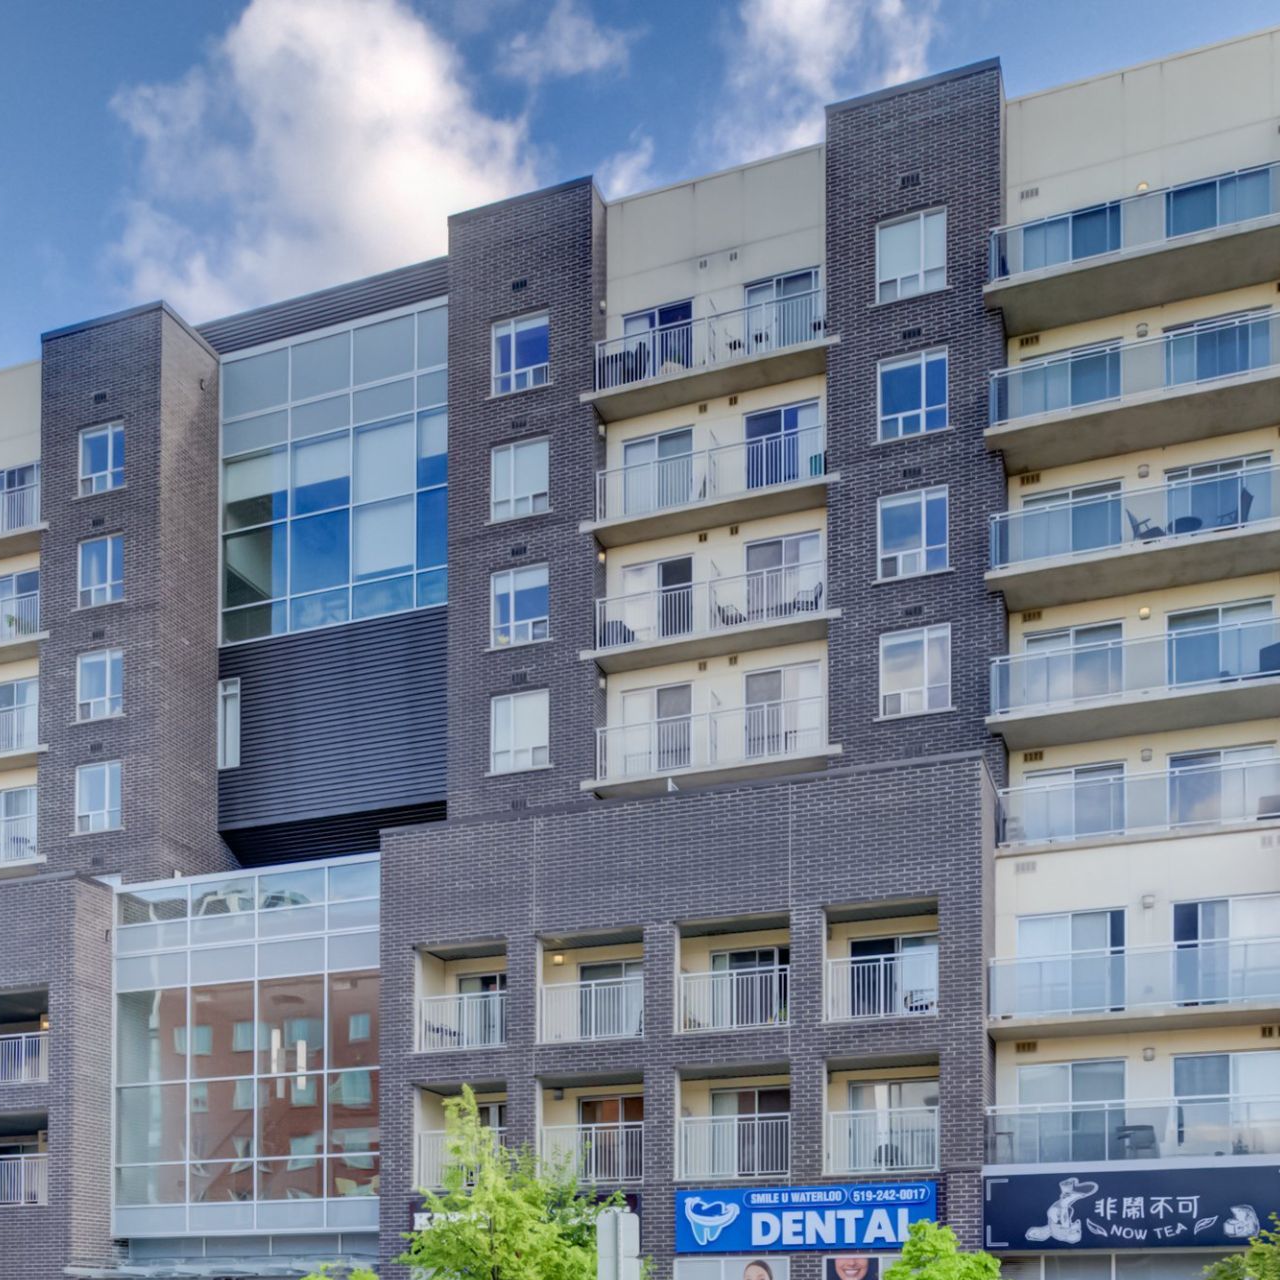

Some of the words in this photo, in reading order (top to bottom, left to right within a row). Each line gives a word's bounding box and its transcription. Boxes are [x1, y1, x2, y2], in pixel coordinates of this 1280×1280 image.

[751, 1192, 779, 1204] SMILE
[781, 1192, 789, 1203] U
[791, 1190, 842, 1203] WATERLOO
[853, 1188, 926, 1201] 519-242-0017
[1094, 1195, 1201, 1220] 非鬧不可
[751, 1207, 910, 1246] DENTAL
[1110, 1225, 1147, 1240] NOW
[1154, 1222, 1188, 1240] TEA
